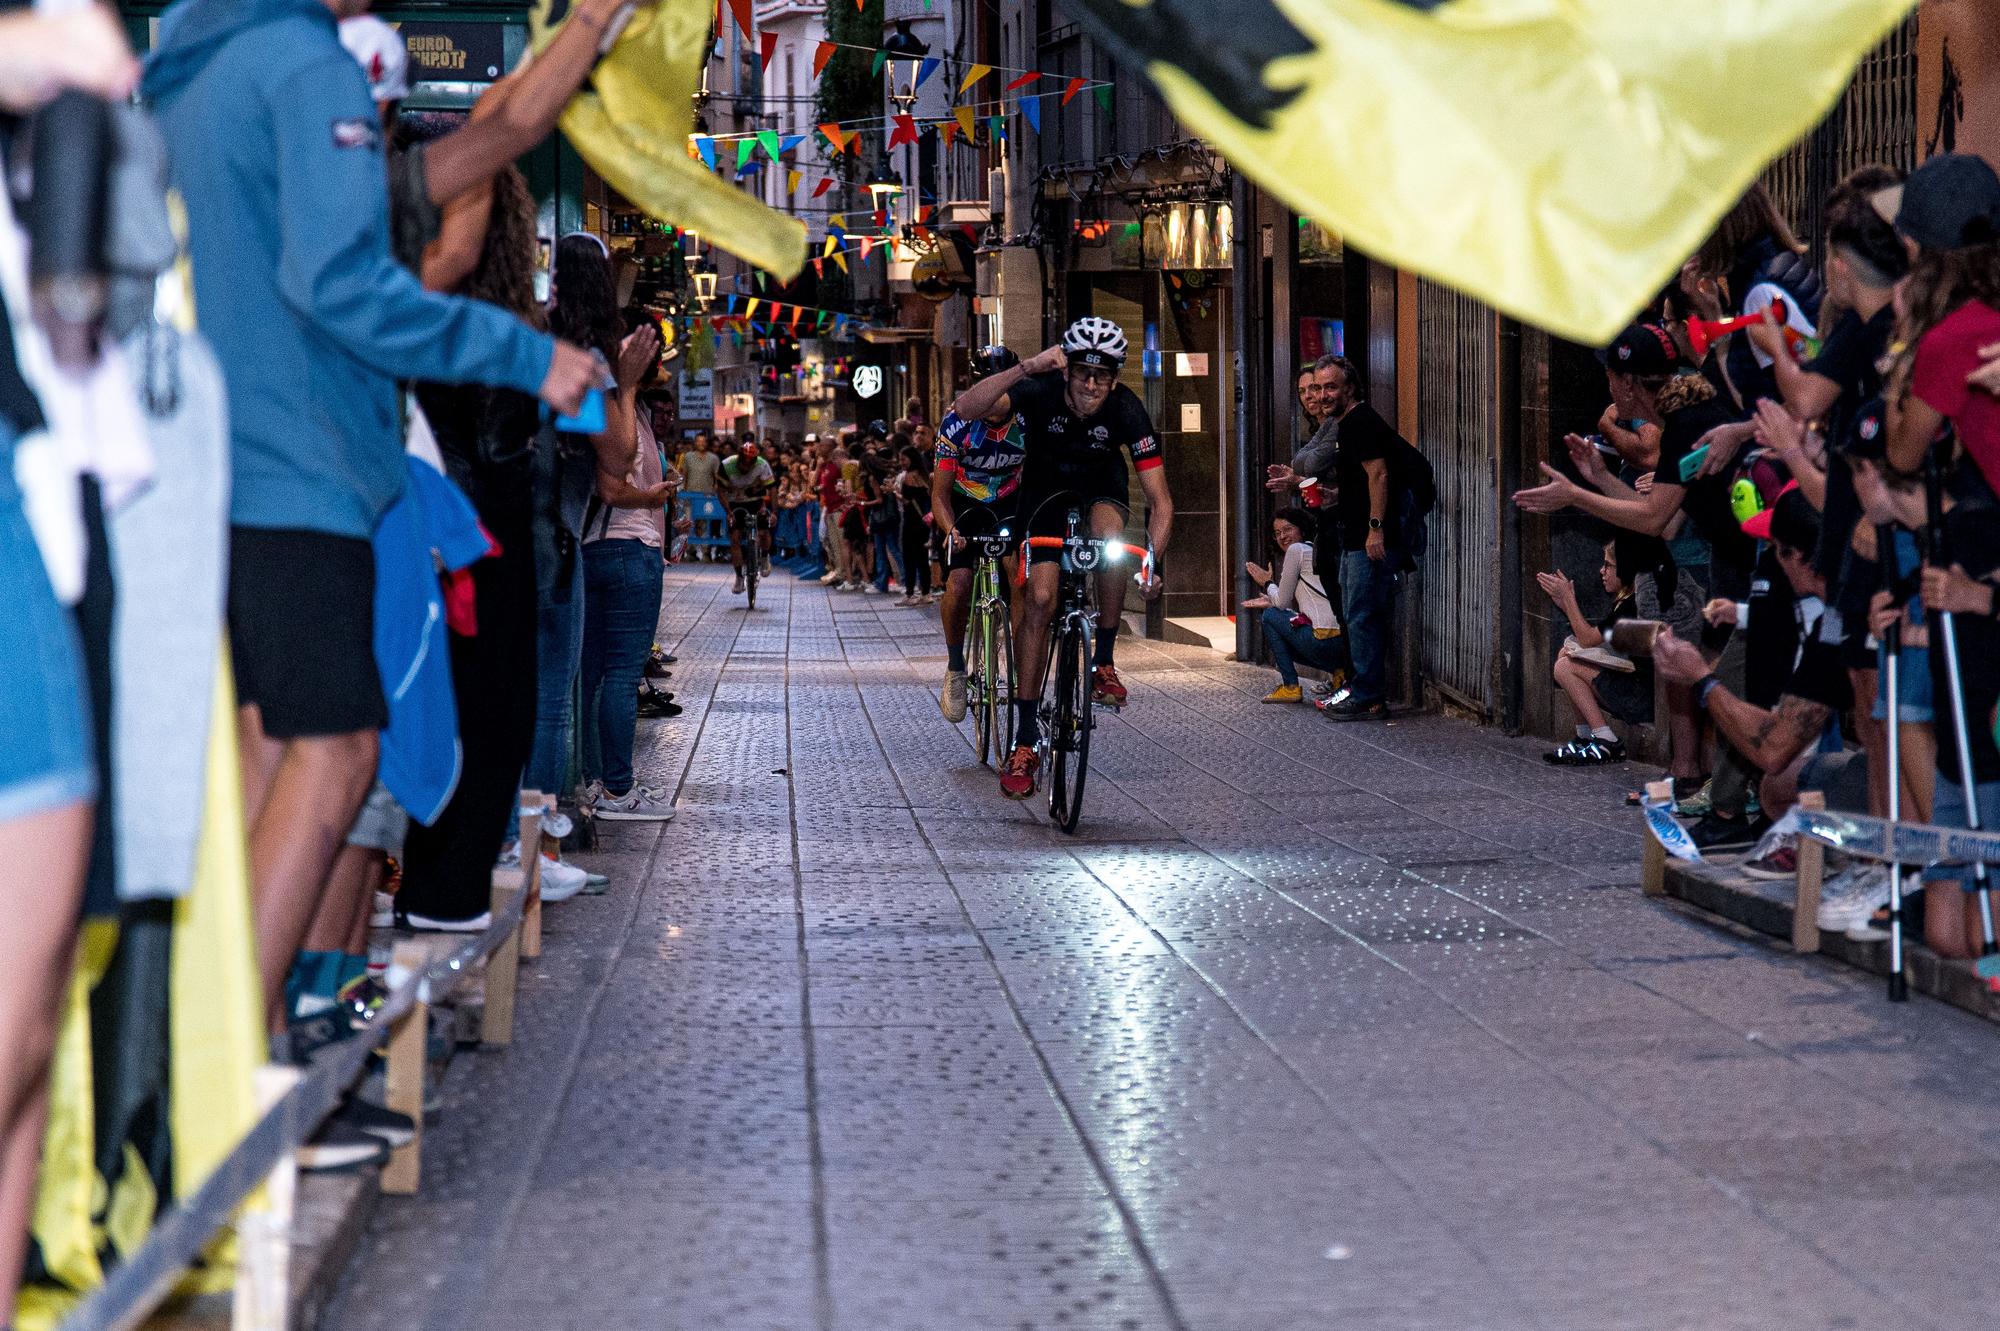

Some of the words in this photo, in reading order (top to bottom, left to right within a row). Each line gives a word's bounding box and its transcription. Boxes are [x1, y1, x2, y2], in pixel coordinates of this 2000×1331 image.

[1085, 353, 1101, 364] 66
[990, 544, 1000, 552] 56
[1079, 551, 1092, 561] 66
